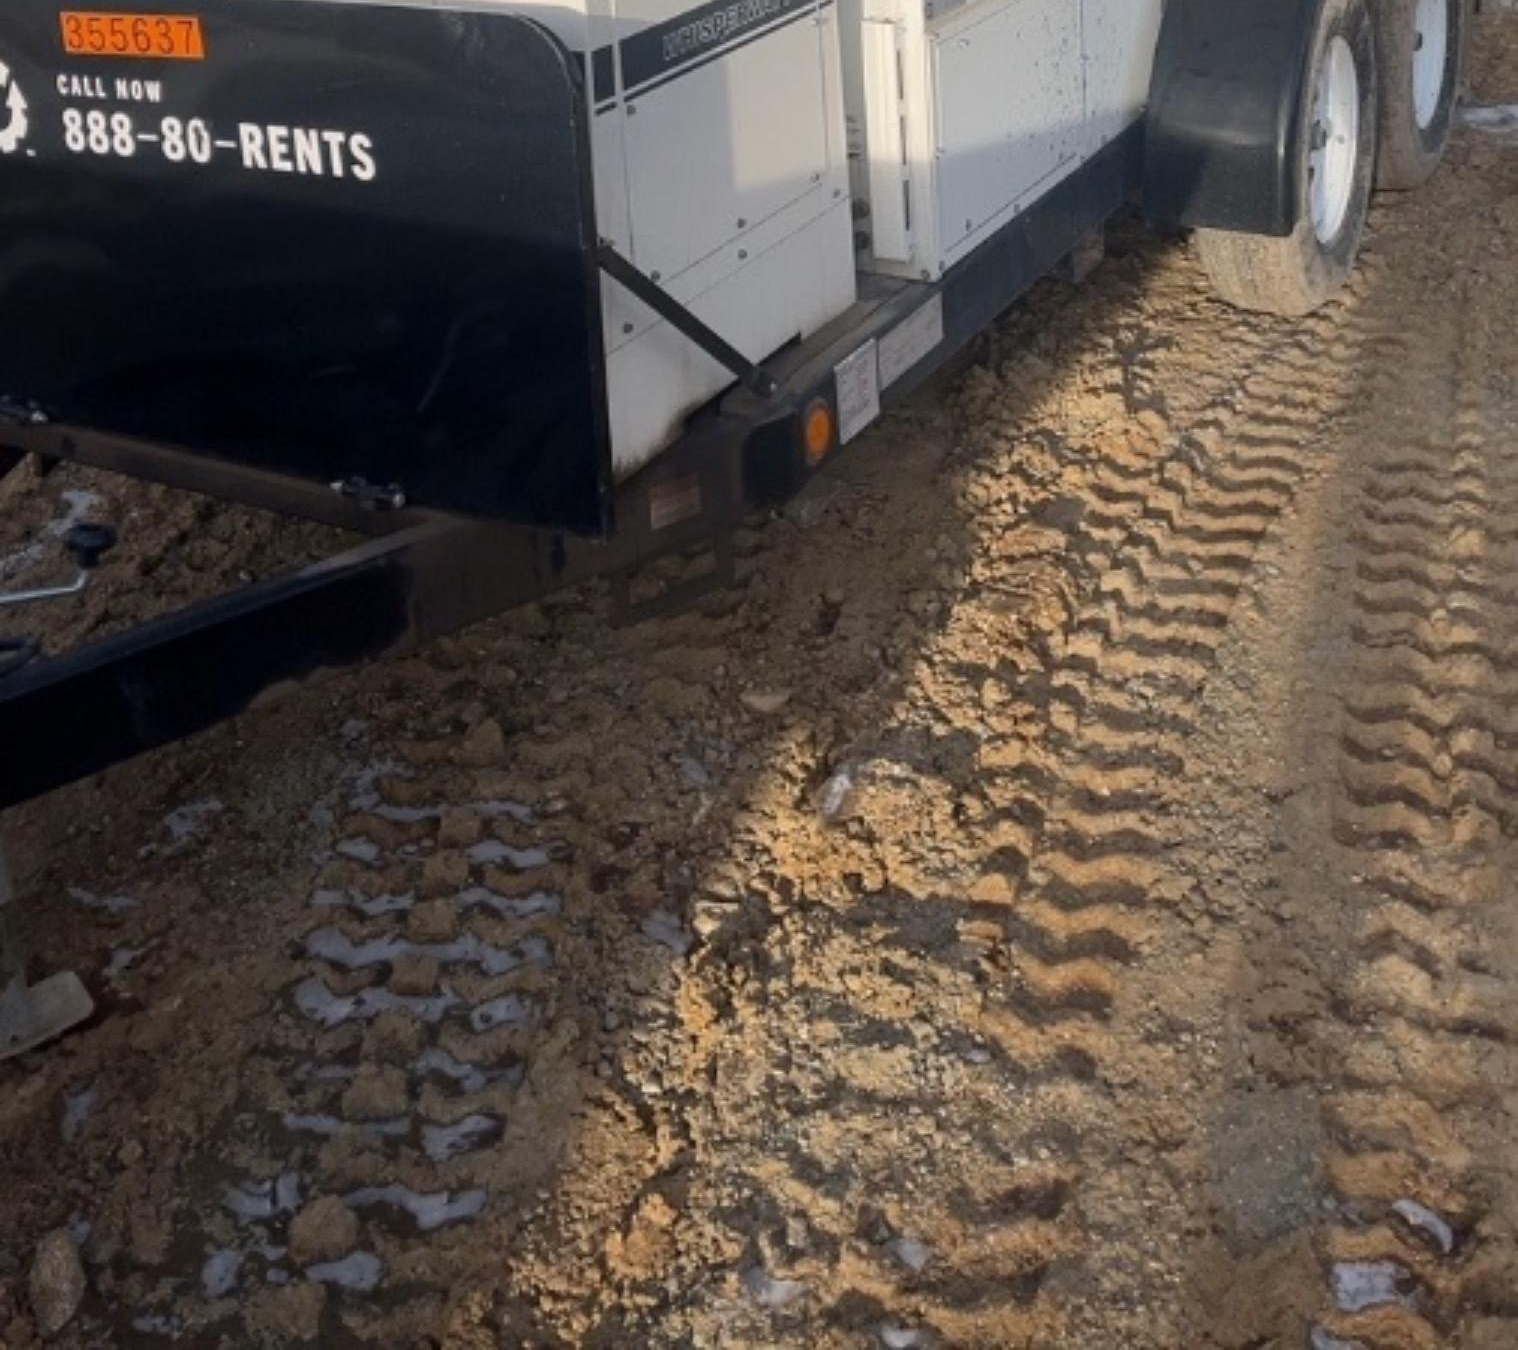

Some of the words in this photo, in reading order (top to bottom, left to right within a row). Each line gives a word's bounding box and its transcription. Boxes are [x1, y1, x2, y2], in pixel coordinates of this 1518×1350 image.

[64, 14, 194, 55] 355637
[56, 73, 106, 99] CALL
[115, 78, 162, 102] NOW
[62, 108, 376, 182] 888-80-RENTS
